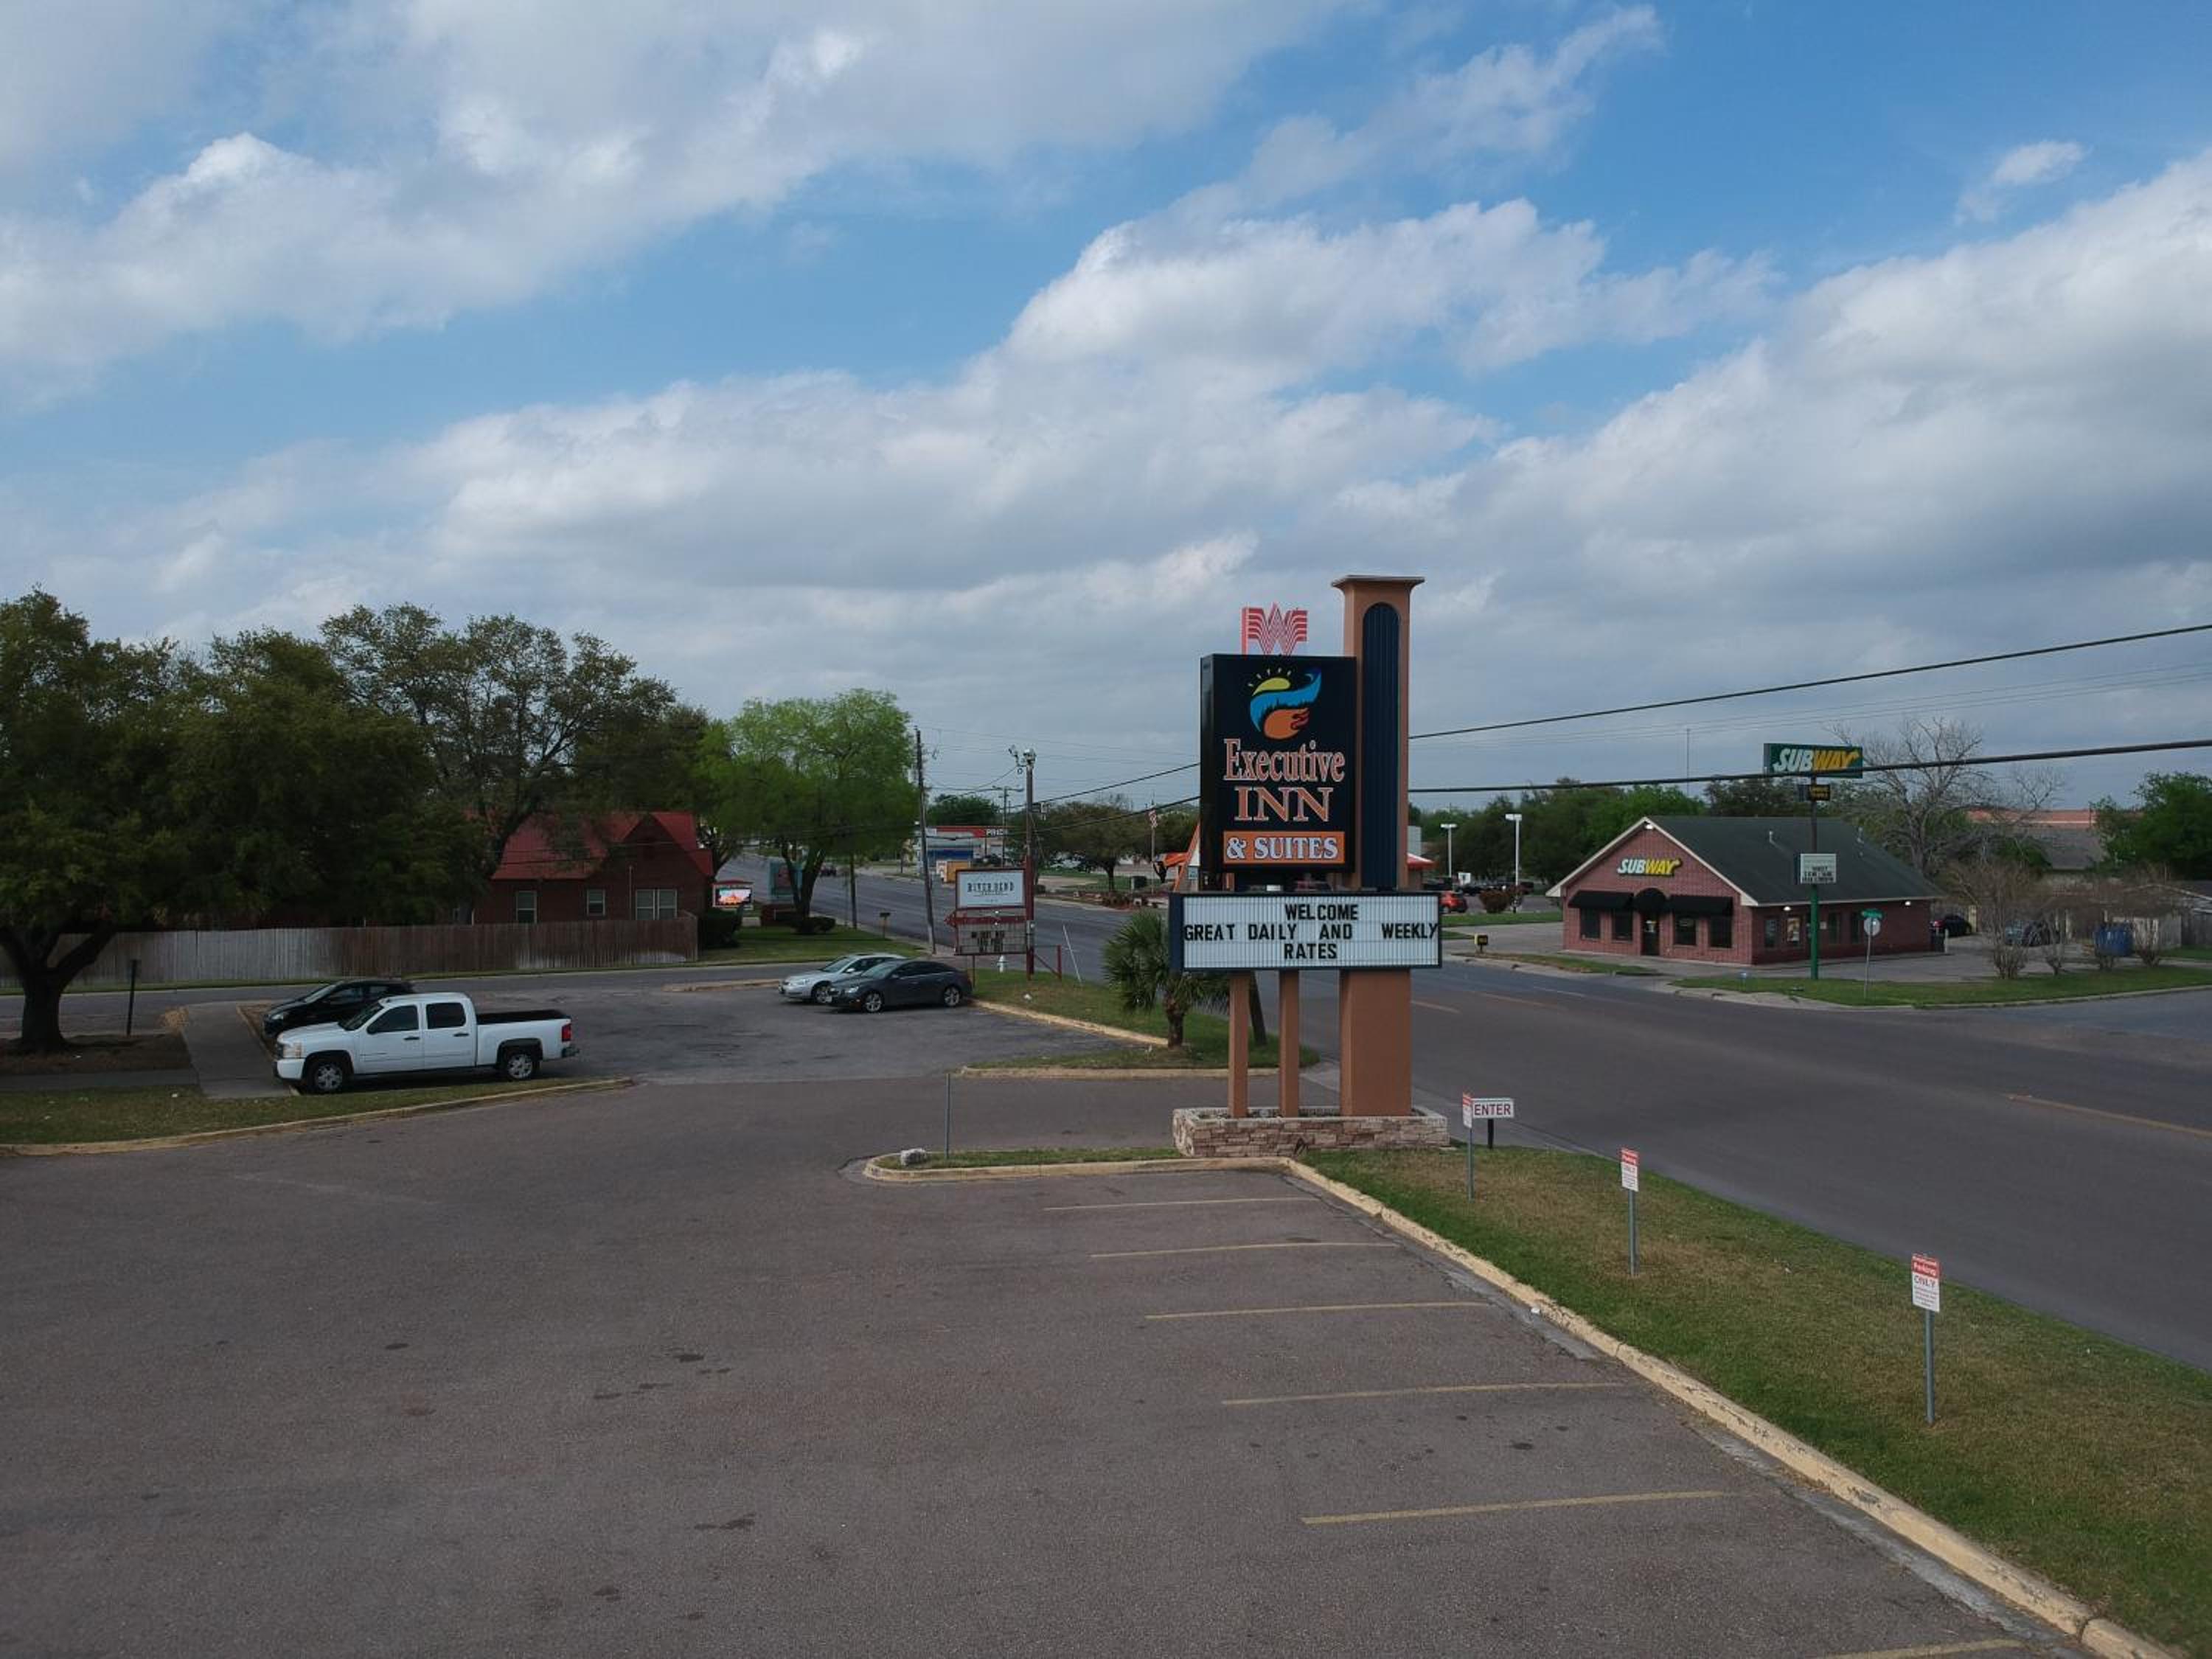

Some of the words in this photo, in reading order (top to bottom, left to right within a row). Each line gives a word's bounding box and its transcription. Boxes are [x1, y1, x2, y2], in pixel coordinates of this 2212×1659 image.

[1223, 738, 1346, 782] Executive
[1772, 748, 1860, 772] SUBWAY
[1234, 786, 1334, 822] INN
[1226, 837, 1247, 859] &
[1254, 837, 1338, 859] SUITES
[1617, 858, 1680, 875] SUBWAY
[1284, 904, 1358, 921] WELCOME
[1184, 925, 1235, 941] GREAT
[1248, 924, 1297, 940] DAILY
[1319, 924, 1352, 940] AND
[1382, 923, 1437, 939] WEEKLY
[1284, 943, 1338, 959] RATES
[1474, 1104, 1512, 1116] ENTER
[1914, 1275, 1936, 1287] ONLY
